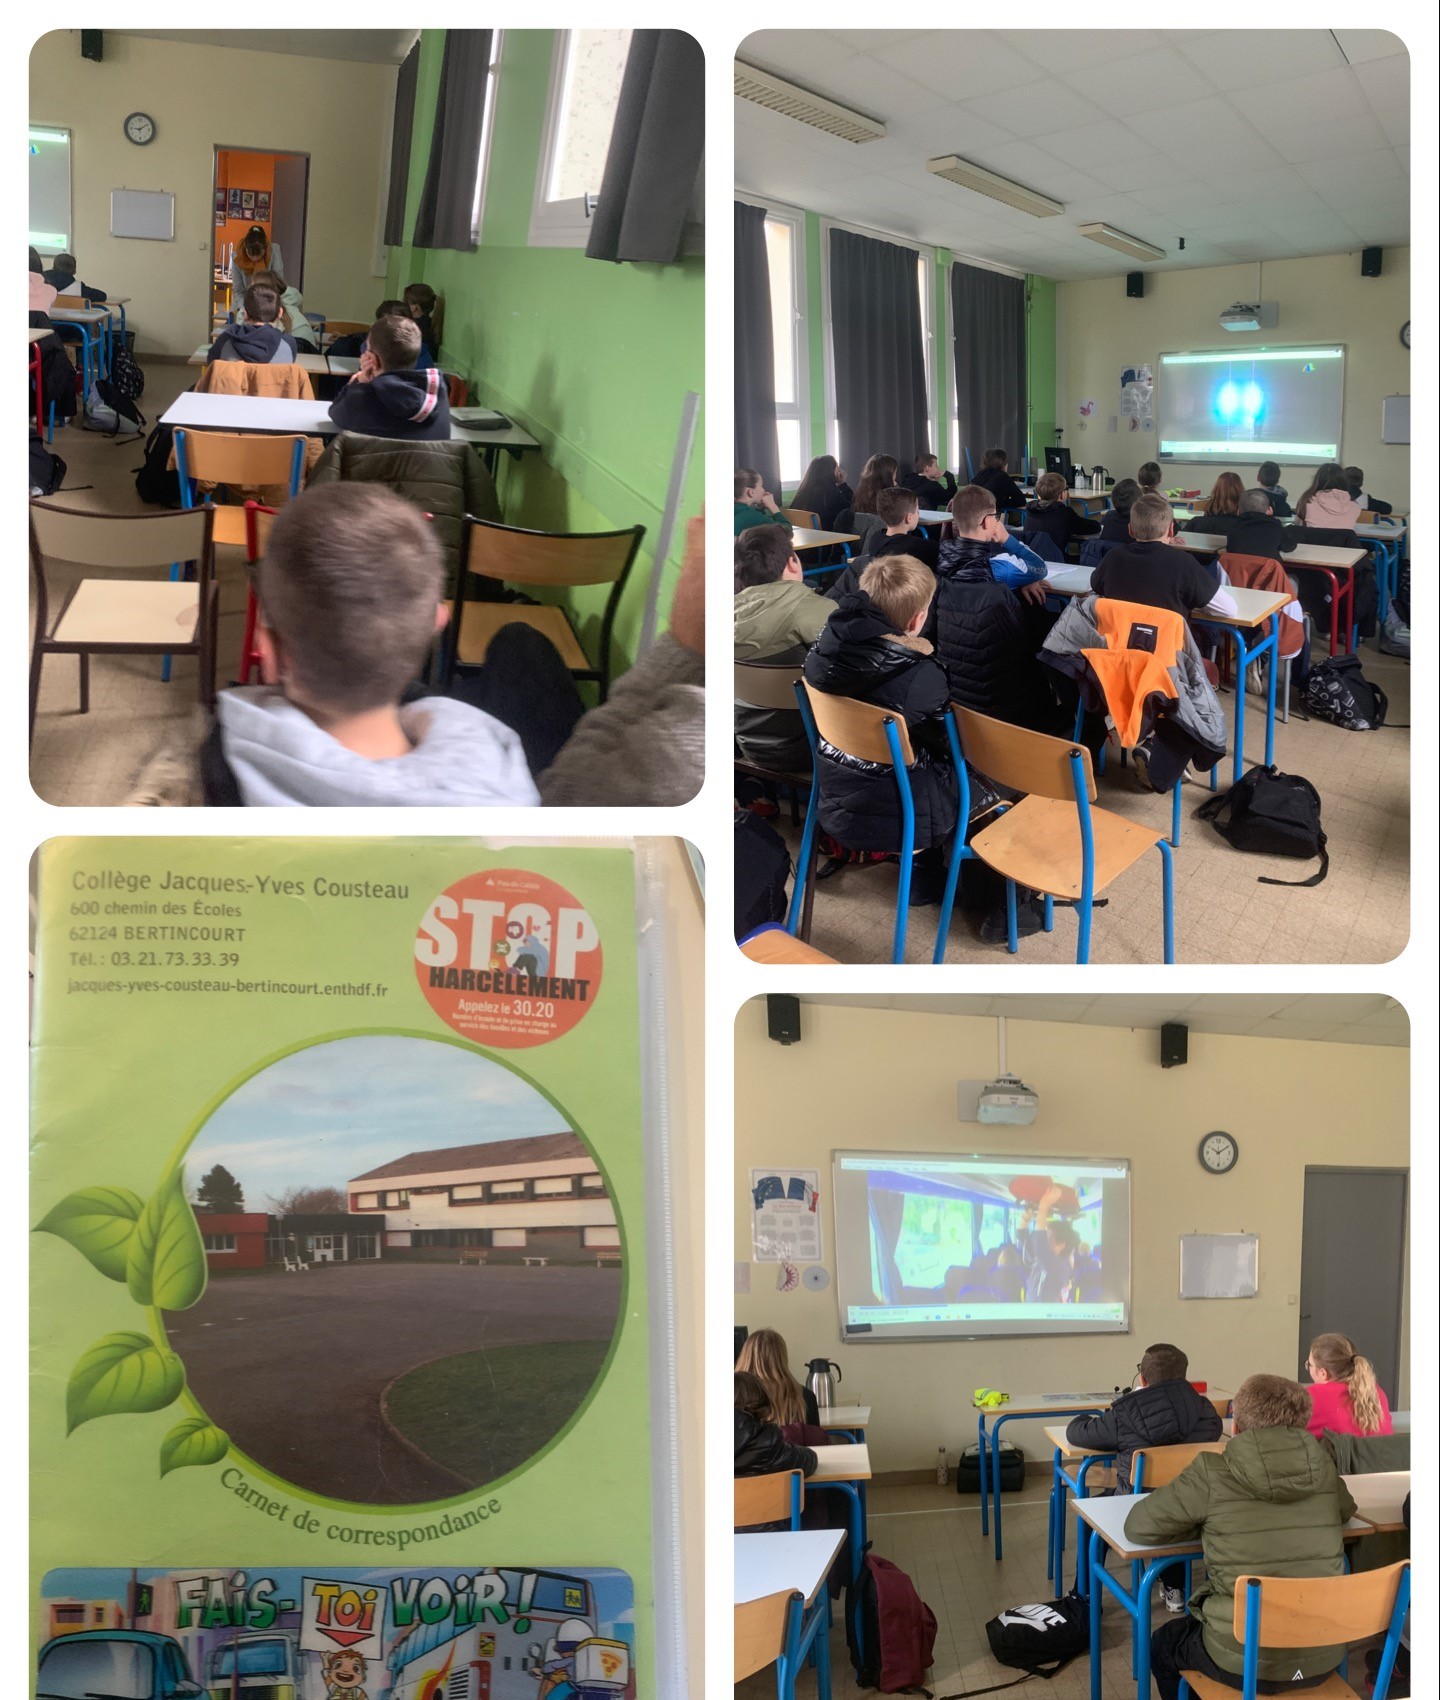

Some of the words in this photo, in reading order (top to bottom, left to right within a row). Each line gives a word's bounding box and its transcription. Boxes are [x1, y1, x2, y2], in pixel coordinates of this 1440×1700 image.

[73, 870, 151, 892] Collège
[160, 871, 305, 895] Jacques-Yves
[314, 877, 409, 899] Cousteau
[70, 901, 99, 915] 600
[104, 901, 157, 915] chemin
[163, 901, 187, 915] des
[193, 900, 242, 917] Écoles
[69, 926, 117, 941] 62124
[124, 925, 246, 942] BERTINCOURT
[414, 895, 600, 979] STOP
[111, 951, 240, 967] 03.21.73.33.39
[67, 978, 388, 997] jacques-yves-cousteau-bertincourt.enthdf.fr
[429, 966, 591, 1001] HARCÈLEMENT
[458, 998, 499, 1013] Appelez
[501, 1002, 511, 1014] le
[513, 999, 554, 1018] 30.20
[220, 1467, 289, 1521] Carnet
[293, 1510, 320, 1534] de
[326, 1498, 502, 1551] correspondance
